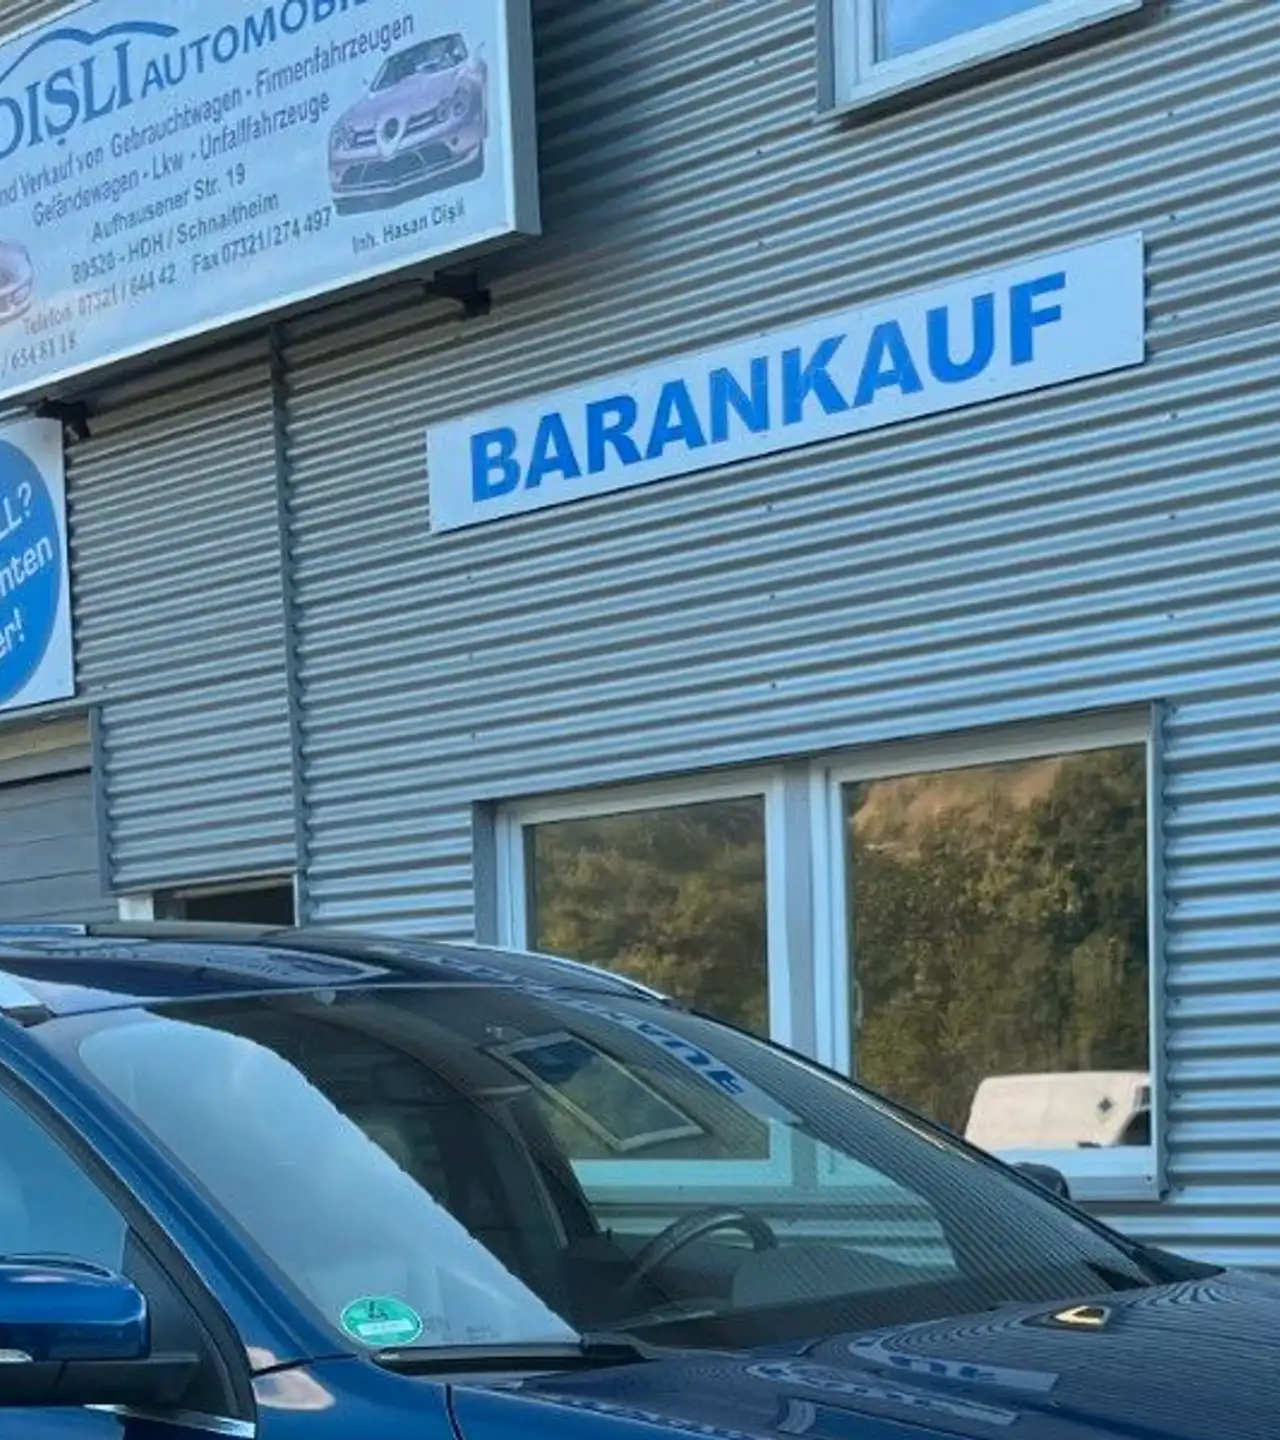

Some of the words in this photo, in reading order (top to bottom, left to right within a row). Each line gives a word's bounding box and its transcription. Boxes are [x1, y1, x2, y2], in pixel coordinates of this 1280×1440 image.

[141, 0, 368, 98] AUTOMOB
[19, 155, 75, 198] Verkauf
[76, 145, 104, 170] von
[110, 86, 242, 158] Gebrauchtwagen
[255, 14, 414, 98] Firmenfahrzeugen
[32, 168, 140, 227] Geländewagen
[152, 151, 184, 181] Lkw
[200, 91, 330, 162] Unfallfahrzeuge
[91, 189, 190, 244] Aufhausener
[194, 176, 220, 203] Str.
[228, 161, 246, 189] 19
[128, 234, 164, 264] HDH
[176, 191, 279, 245] Schnaitheim
[191, 250, 219, 277] Fax
[382, 214, 428, 244] Hasan
[469, 271, 1066, 503] BARANKAUF
